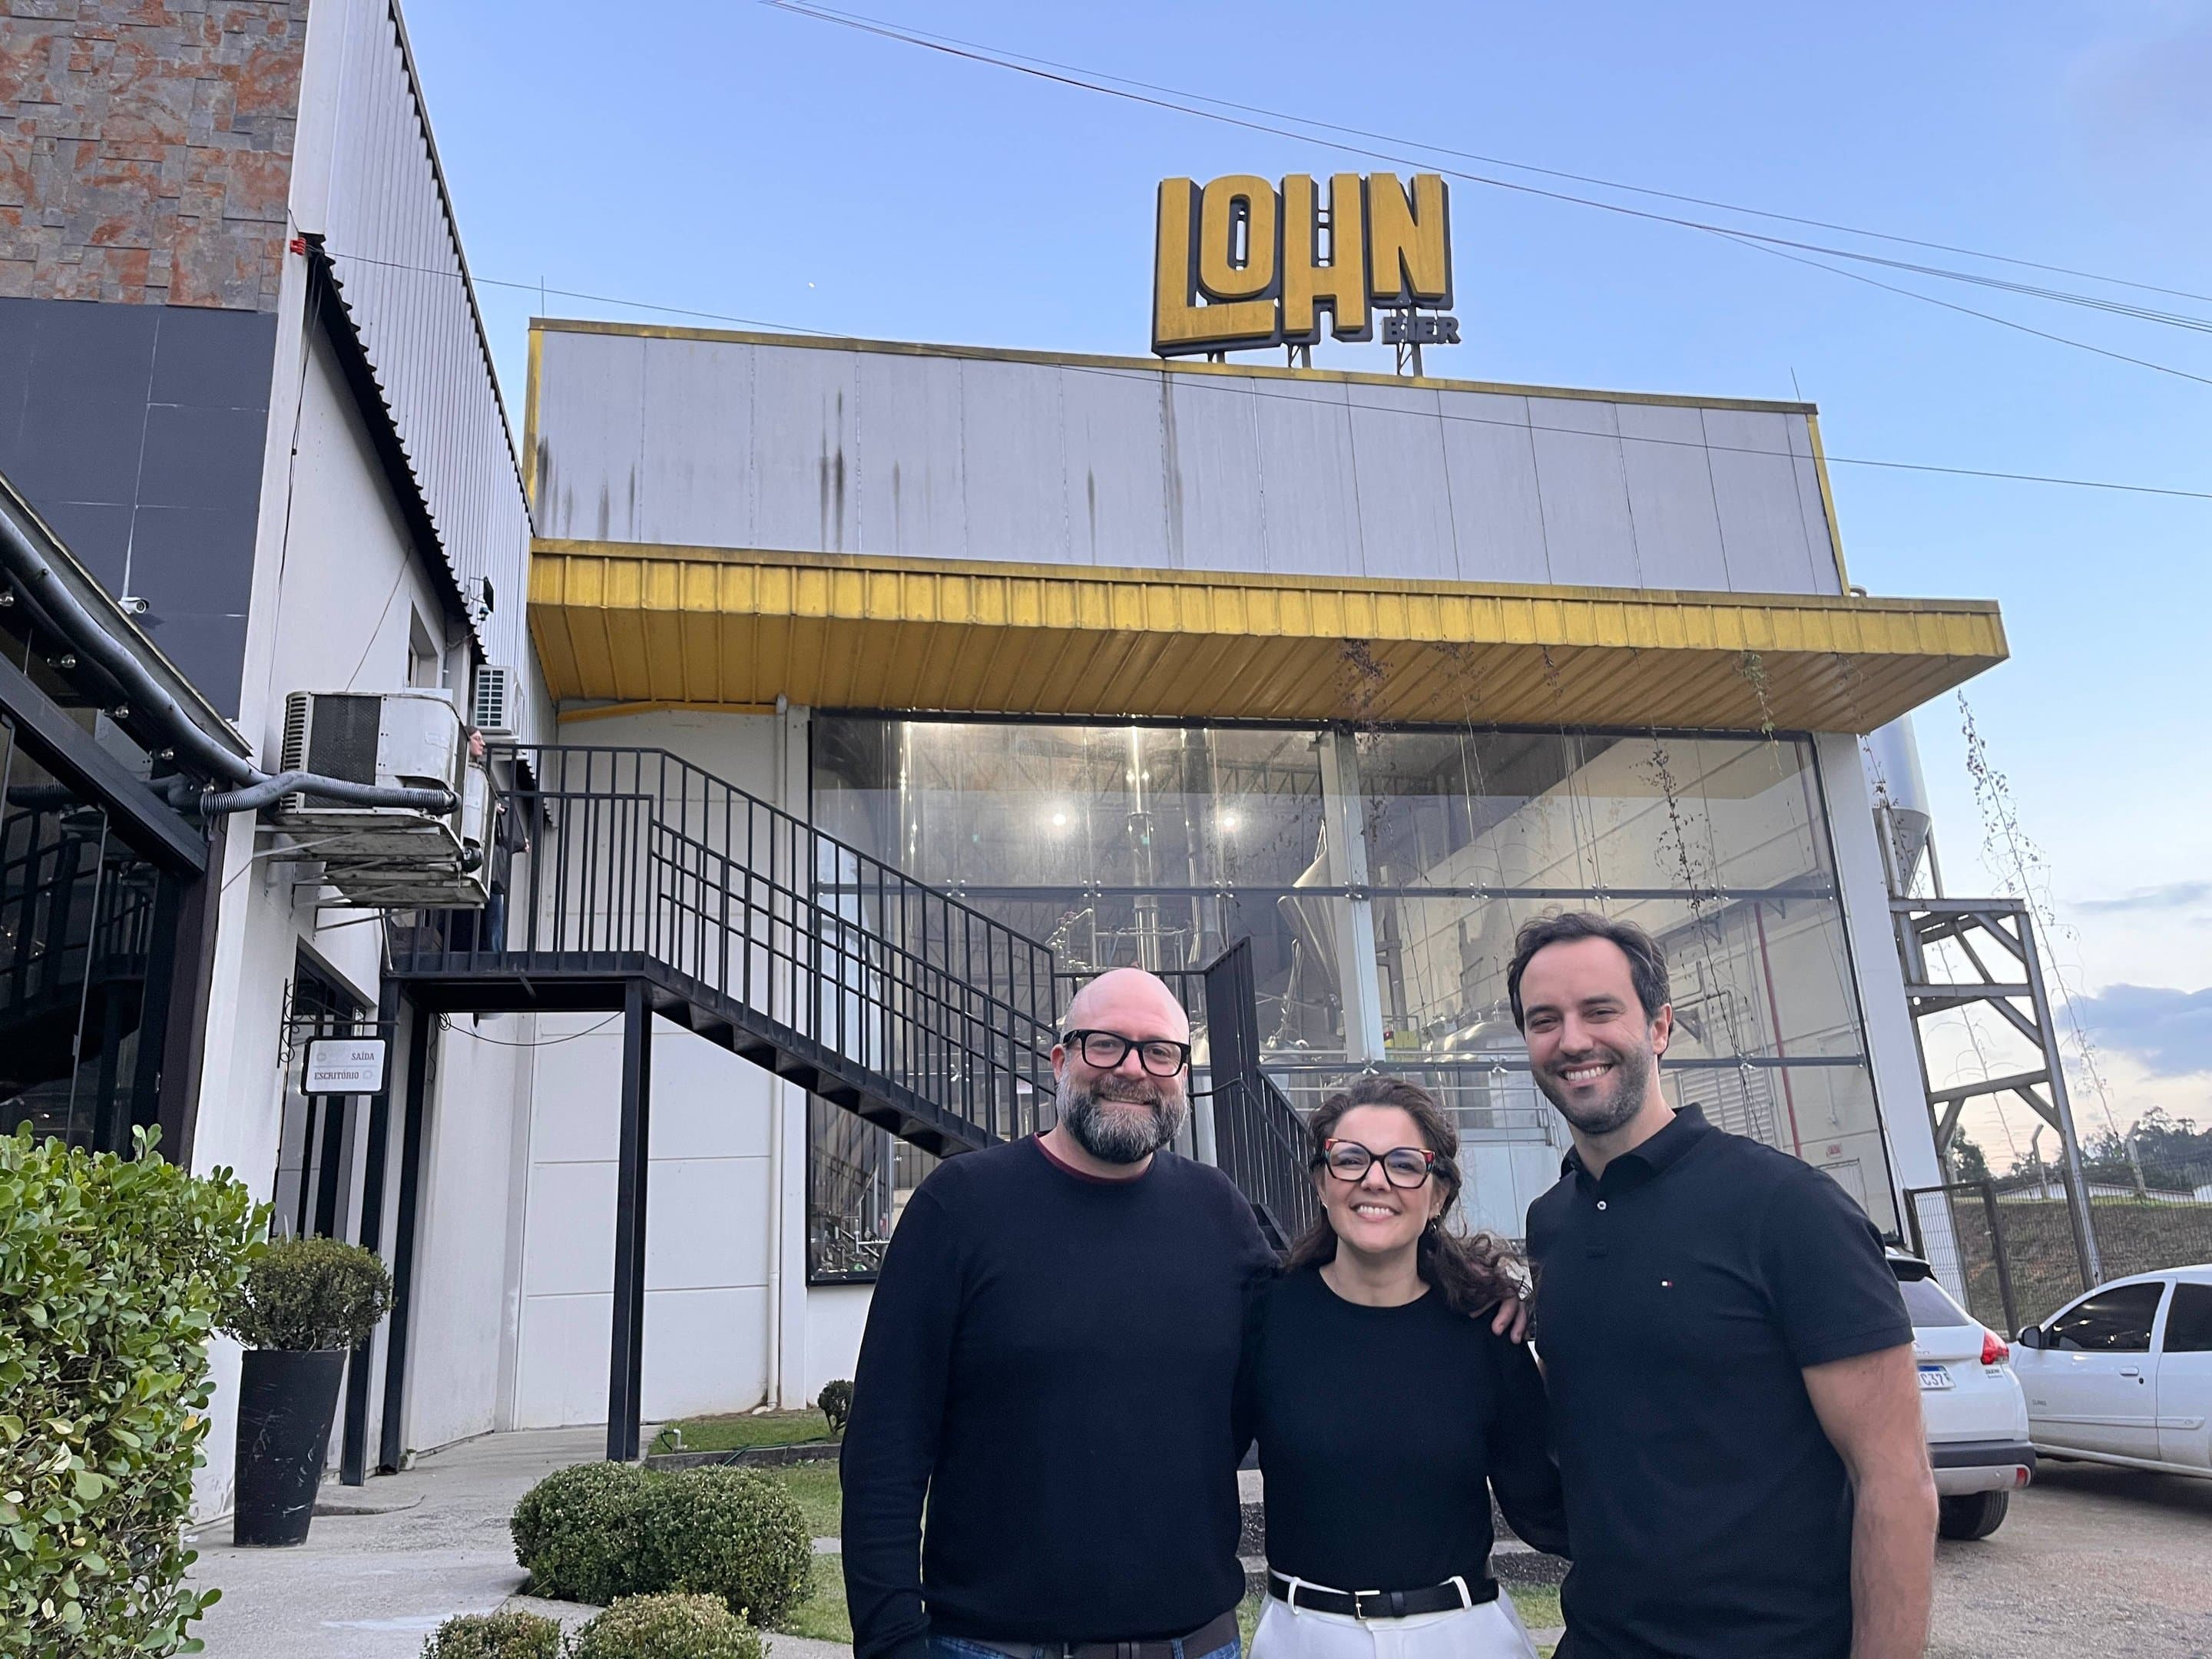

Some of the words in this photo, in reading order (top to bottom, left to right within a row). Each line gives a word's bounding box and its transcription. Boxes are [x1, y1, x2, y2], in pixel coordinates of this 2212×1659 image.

[1154, 173, 1451, 353] LOHN
[1382, 316, 1462, 345] BIER
[351, 1051, 375, 1061] SAÍDA
[314, 1070, 359, 1080] ESCRITÓRIO
[1919, 1373, 1945, 1386] C37
